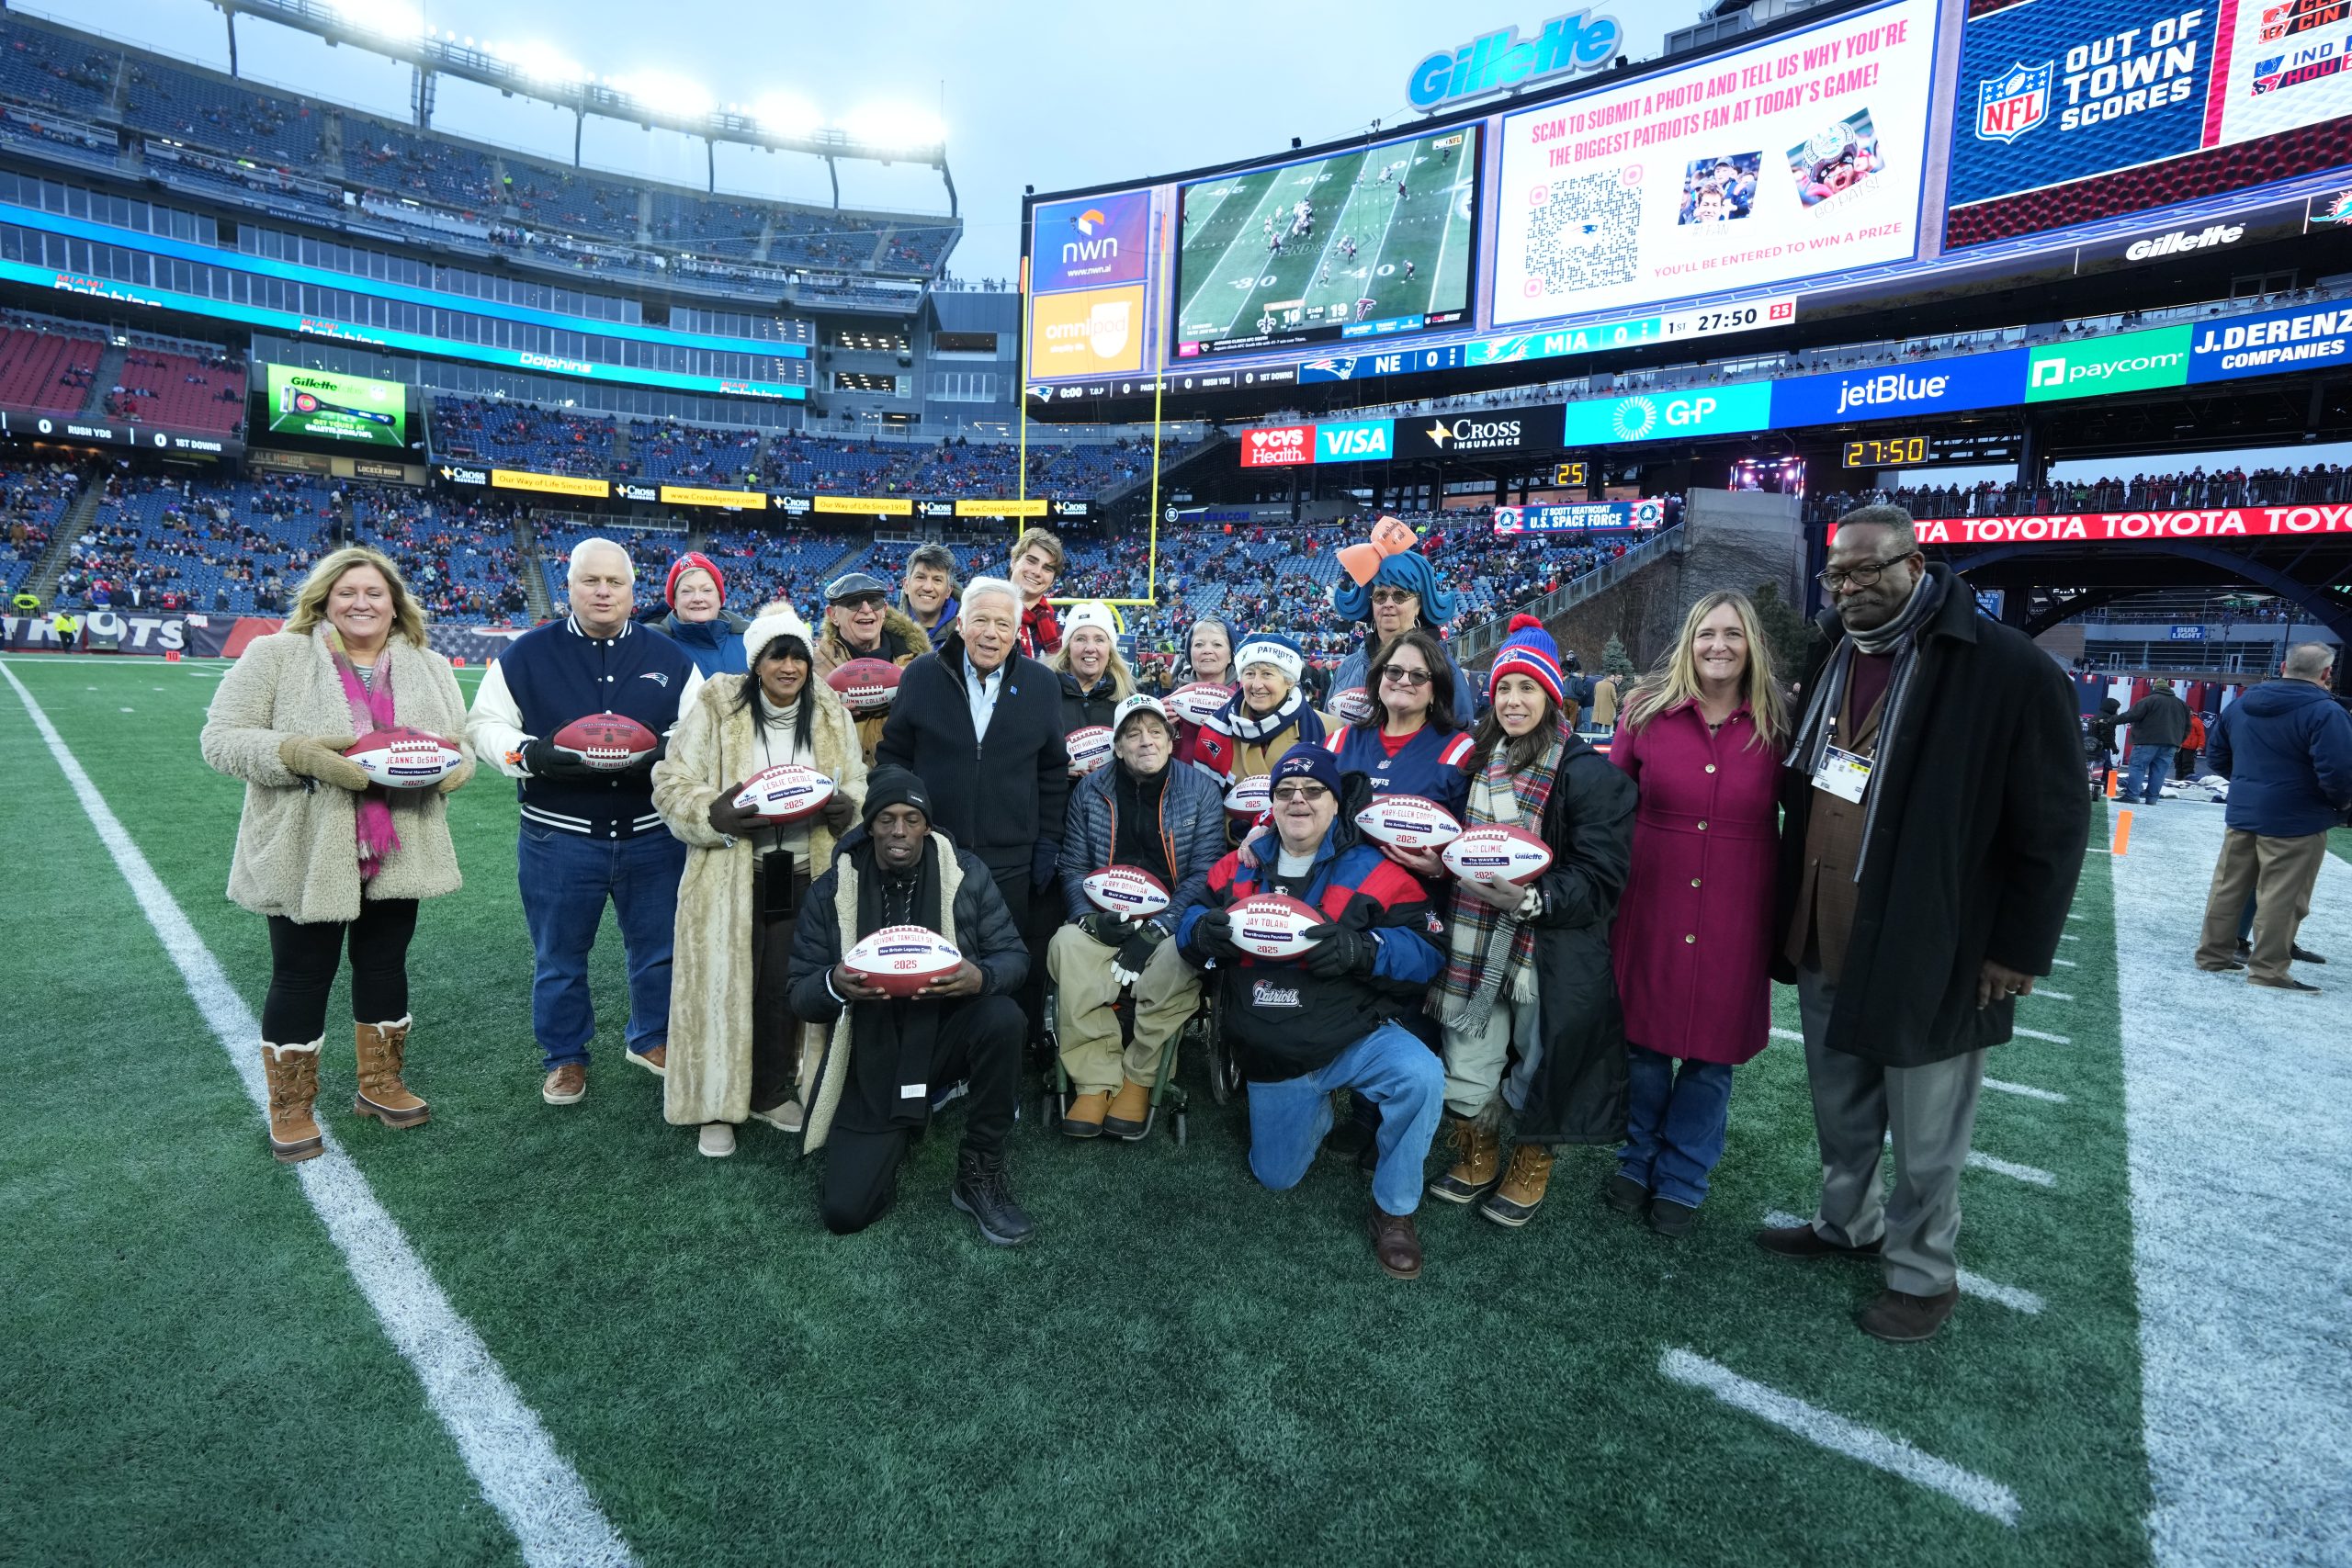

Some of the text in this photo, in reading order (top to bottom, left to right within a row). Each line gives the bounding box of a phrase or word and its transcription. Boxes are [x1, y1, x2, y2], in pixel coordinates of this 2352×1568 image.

[2298, 6, 2340, 31] CIN
[2065, 9, 2204, 73] OUT OF
[1409, 14, 1616, 106] Gillette
[2293, 42, 2334, 66] IND
[1532, 18, 1908, 143] SCAN TO SUBMIT A PHOTO AND TELL US WHY YOU'RE
[2064, 39, 2198, 106] TOWN
[2286, 59, 2336, 85] HOU
[1984, 92, 2041, 133] NFL
[2060, 76, 2192, 131] SCORES
[1549, 62, 1880, 168] THE BIGGEST PATRIOTS FAN AT TODAY'S GAME!
[269, 209, 287, 218] BANK
[298, 216, 326, 226] AMERICA
[1063, 237, 1117, 263] nwn
[1655, 221, 1903, 277] YOU'LL BE ENTERED TO WIN A PRIZE
[2125, 226, 2244, 261] Gillette
[56, 274, 104, 289] MIAMI
[1283, 310, 1301, 323] 10
[1330, 303, 1348, 318] 19
[1698, 308, 1758, 331] 27:50
[1772, 304, 1790, 318] 25
[300, 319, 339, 330] MIAMI
[1544, 327, 1627, 354] MIA 0
[520, 352, 592, 374] Dolphins
[1375, 351, 1438, 374] NE 0
[2222, 339, 2345, 370] COMPANIES
[2070, 354, 2177, 383] paycom
[291, 377, 337, 391] Gillette
[1060, 387, 1082, 399] 0:00
[1123, 383, 1130, 394] 0
[1185, 378, 1193, 389] 0
[1203, 378, 1217, 387] RUSH
[1246, 373, 1253, 383] 0
[1271, 371, 1294, 381] DOWNS
[1838, 373, 1949, 414] jetBlue
[39, 419, 221, 452] 0 RUSH YDS 0 1ST DOWNS
[1269, 429, 1303, 447] CVS
[1323, 428, 1386, 455] VISA
[1453, 438, 1520, 450] INSURANCE
[1252, 446, 1306, 464] Health.
[1848, 438, 1924, 466] 27:50
[499, 475, 602, 491] Our Way of Life Since 1954
[1558, 464, 1583, 485] 25
[820, 502, 907, 513] Our Way Life Since 1954
[1204, 512, 1250, 522] BEACON
[1542, 505, 1611, 516] LT SCOTT HEATHCOAT
[1530, 513, 1622, 528] U.S. SPACE FORCE
[1962, 517, 2086, 540] TOYOTA
[2102, 510, 2245, 537] TOYOTA
[1257, 647, 1294, 663] PATRIOTS
[763, 778, 786, 791] LESLIE
[784, 799, 804, 809] 2025
[1382, 809, 1415, 818] MARY-ELLEN
[1439, 823, 1459, 833] Gillette
[1396, 835, 1418, 843] 2025
[1102, 880, 1119, 888] JERRY
[1122, 883, 1148, 894] DONOVAN
[1112, 903, 1130, 911] 2025
[1246, 918, 1288, 929] JAY TOLAND
[938, 945, 959, 957] Gillette
[1257, 945, 1278, 953] 2025
[894, 960, 917, 969] 2025
[1254, 987, 1299, 1006] Patriots
